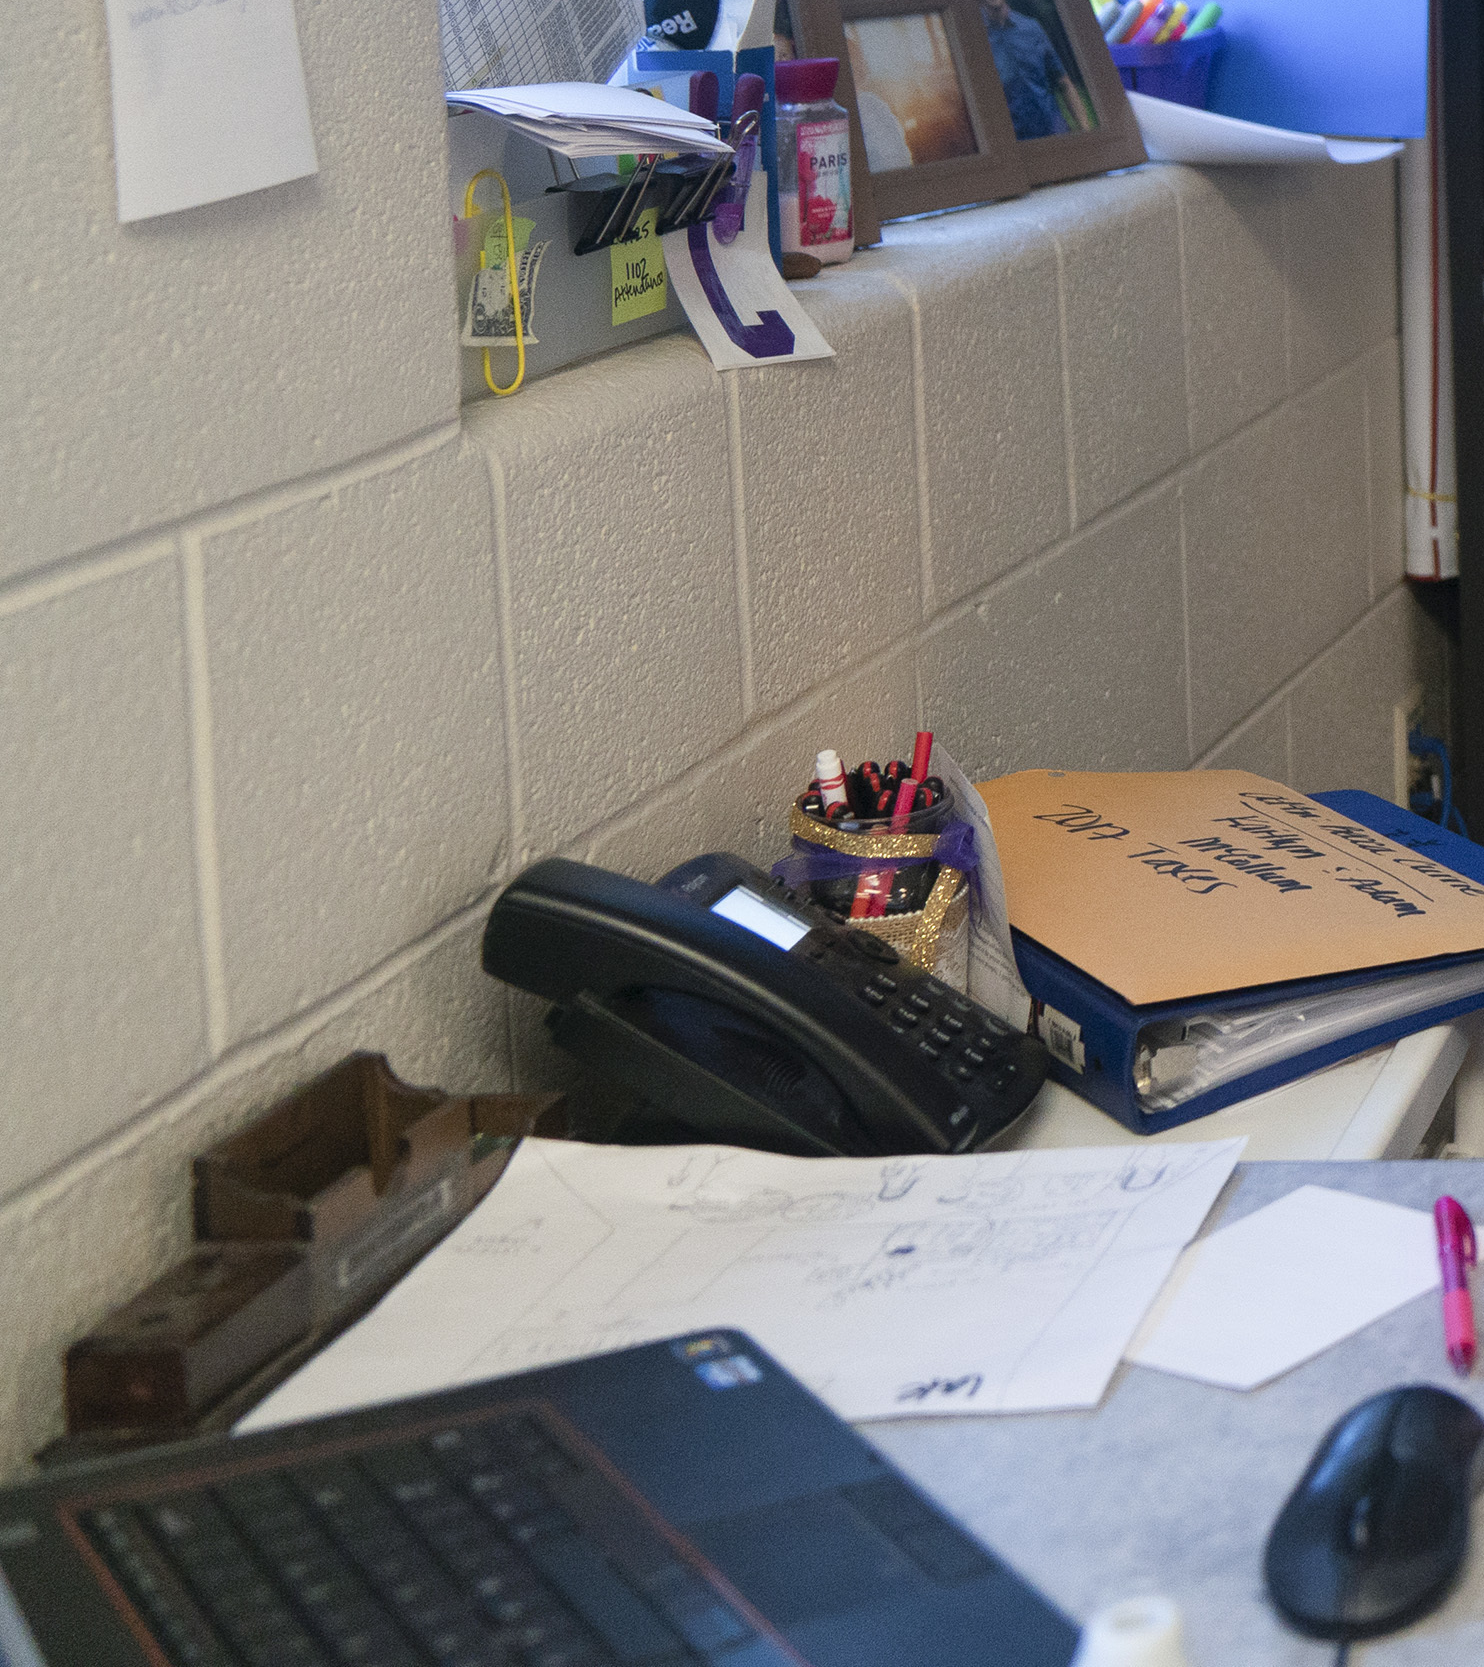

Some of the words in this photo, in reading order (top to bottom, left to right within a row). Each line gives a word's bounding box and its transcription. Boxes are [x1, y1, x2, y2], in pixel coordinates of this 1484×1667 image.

[647, 9, 699, 36] Rea
[810, 152, 849, 170] PARIS
[626, 258, 649, 281] 1102
[1033, 804, 1131, 842] 2017
[1127, 842, 1239, 895] Taxes
[1334, 877, 1427, 919] Adam
